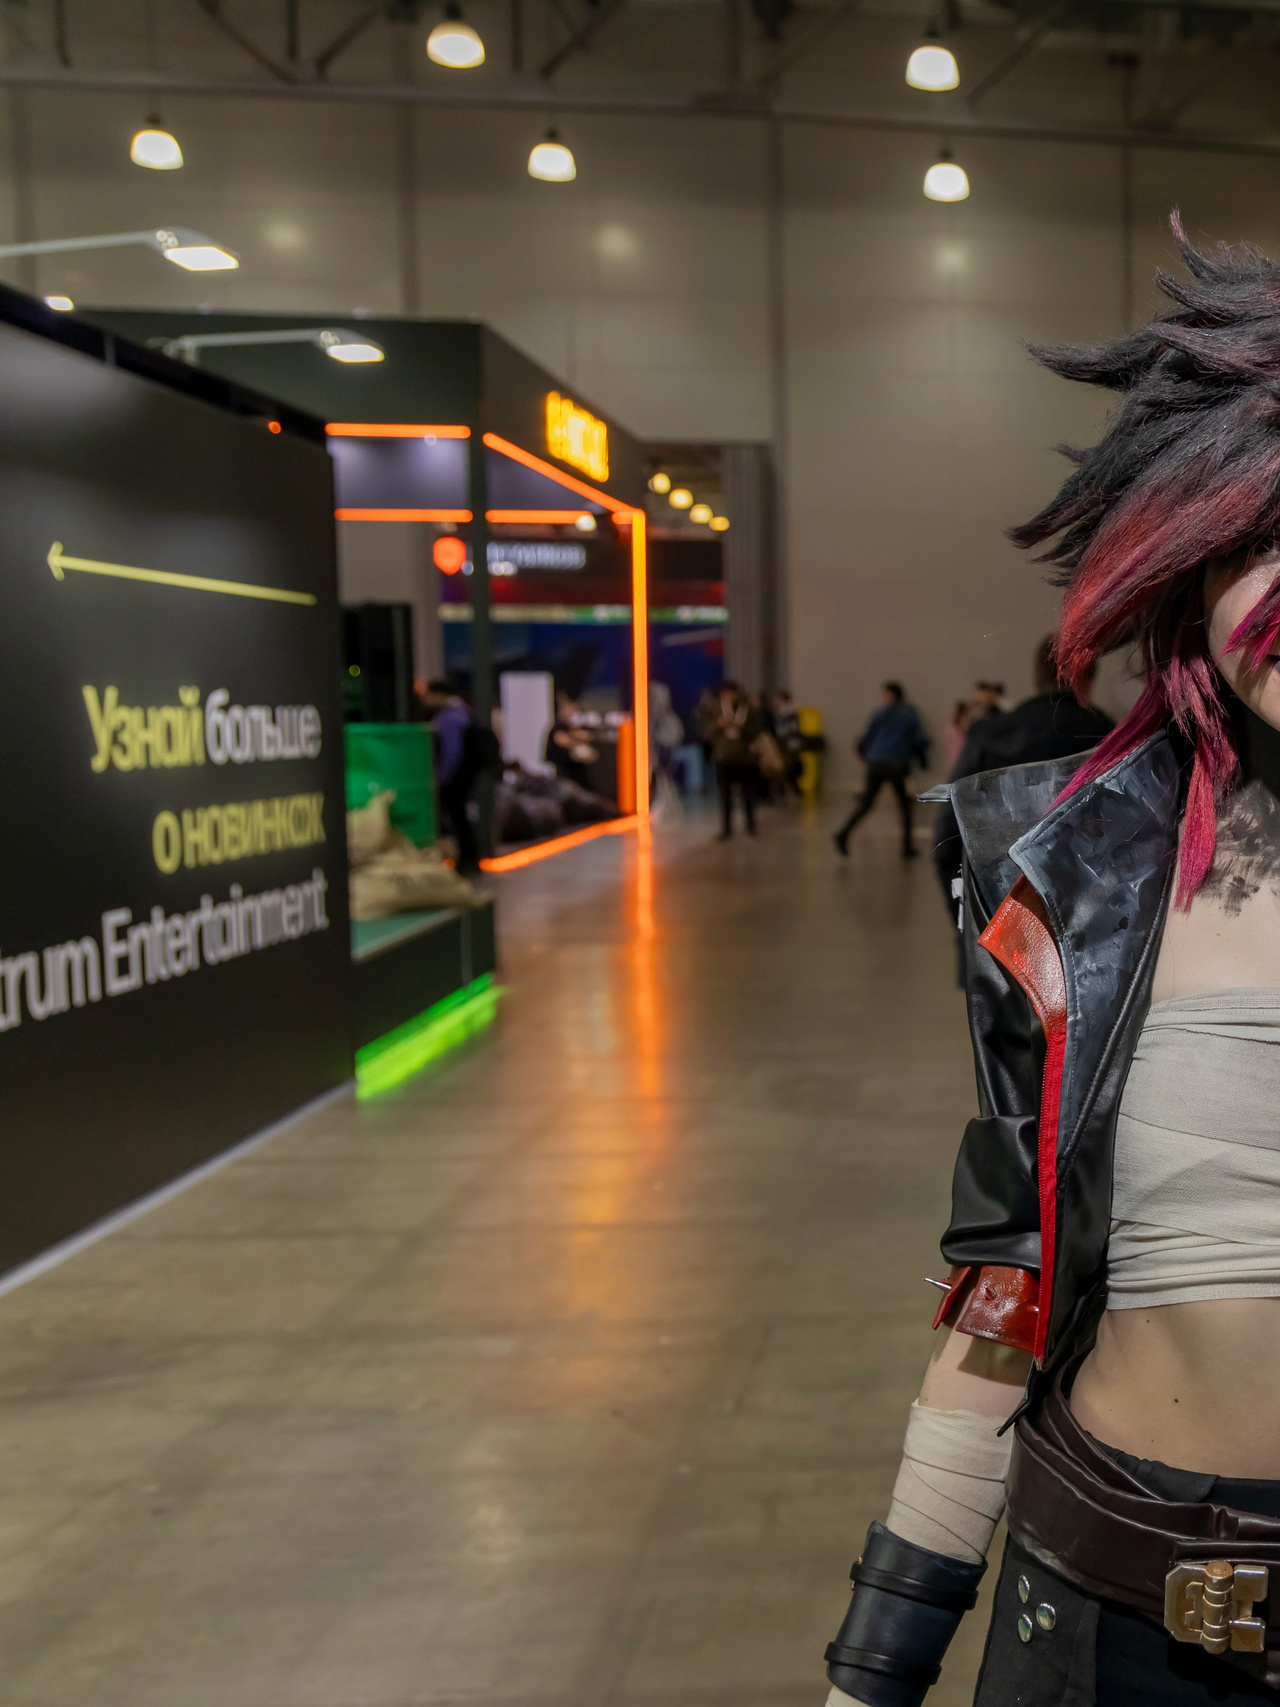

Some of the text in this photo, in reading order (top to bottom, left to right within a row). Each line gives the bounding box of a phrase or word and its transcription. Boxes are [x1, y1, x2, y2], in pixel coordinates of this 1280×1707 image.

[82, 685, 322, 773] Узнай больше
[183, 792, 326, 869] новинках
[101, 867, 330, 997] Entertainment
